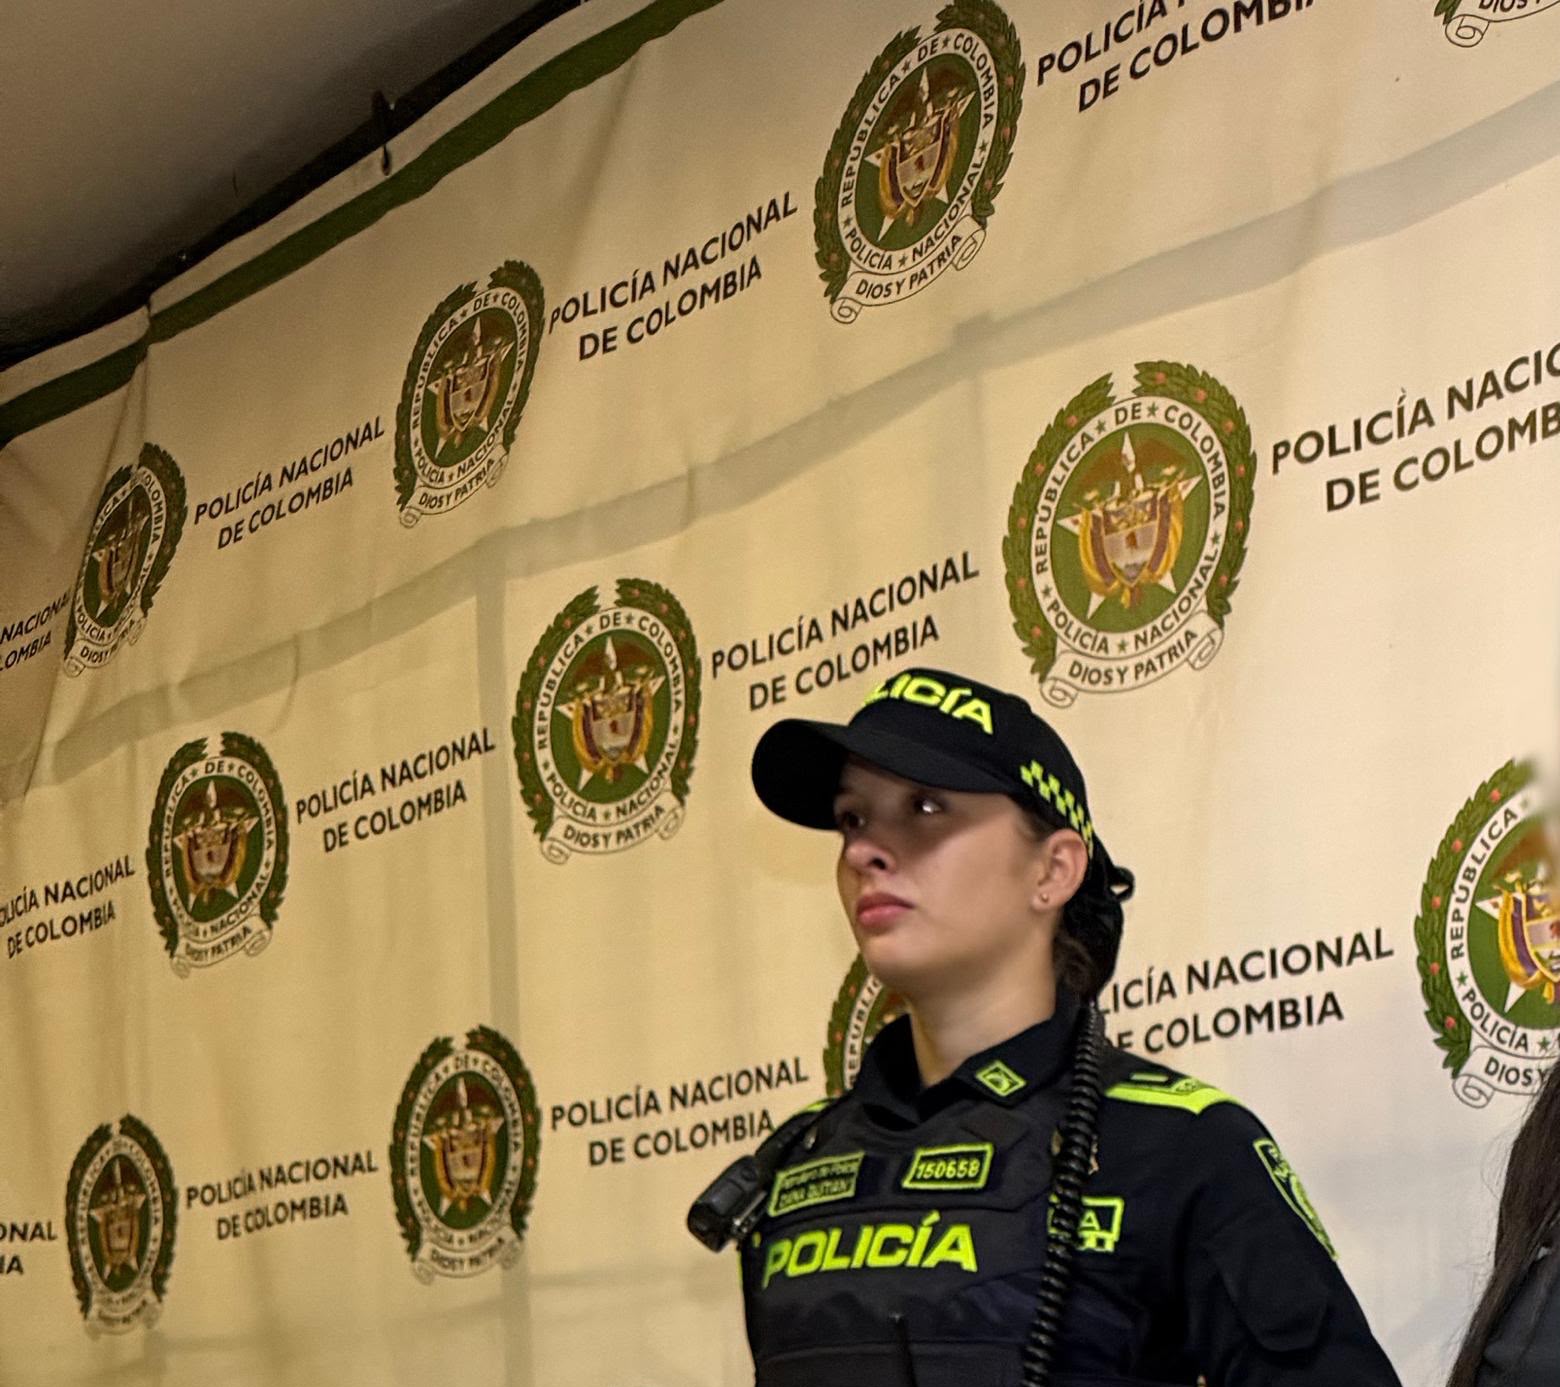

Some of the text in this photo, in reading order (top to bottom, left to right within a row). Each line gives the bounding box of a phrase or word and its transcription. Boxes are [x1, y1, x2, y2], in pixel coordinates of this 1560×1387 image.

[918, 38, 938, 62] DE
[953, 32, 997, 129] COLOMBIA
[1079, 63, 1121, 112] DE
[911, 161, 982, 262] NACIONAL
[549, 191, 798, 335] POLICÍA NACIONAL
[909, 234, 963, 290] PATRIA
[579, 255, 762, 361] DE COLOMBIA
[1114, 402, 1142, 426] DE
[1164, 404, 1226, 520] COLOMBIA
[1272, 389, 1435, 475] POLICÍA
[194, 472, 272, 525] POLICÍA
[279, 416, 384, 488] NACIONAL
[218, 467, 353, 549] DE COLOMBIA
[1326, 468, 1381, 512] DE
[712, 551, 979, 679] POLICÍA NACIONAL
[1133, 546, 1219, 651] NACIONAL
[750, 615, 939, 711] DE COLOMBIA
[1133, 628, 1198, 680] PATRIA
[296, 727, 496, 824] POLICÍA NACIONAL
[323, 779, 467, 853] DE COLOMBIA
[44, 855, 136, 906] NACIONAL
[7, 901, 116, 959] DE COLOMBIA
[1186, 928, 1395, 995] NACIONAL
[1145, 991, 1344, 1054] COLOMBIA
[551, 1084, 661, 1131] POLICÍA
[670, 1056, 809, 1111] NACIONAL
[260, 1150, 378, 1191] NACIONAL
[589, 1109, 775, 1166] DE COLOMBIA
[916, 1159, 979, 1179] 150658
[217, 1193, 348, 1240] DE COLOMBIA
[763, 1210, 978, 1289] POLICÍA
